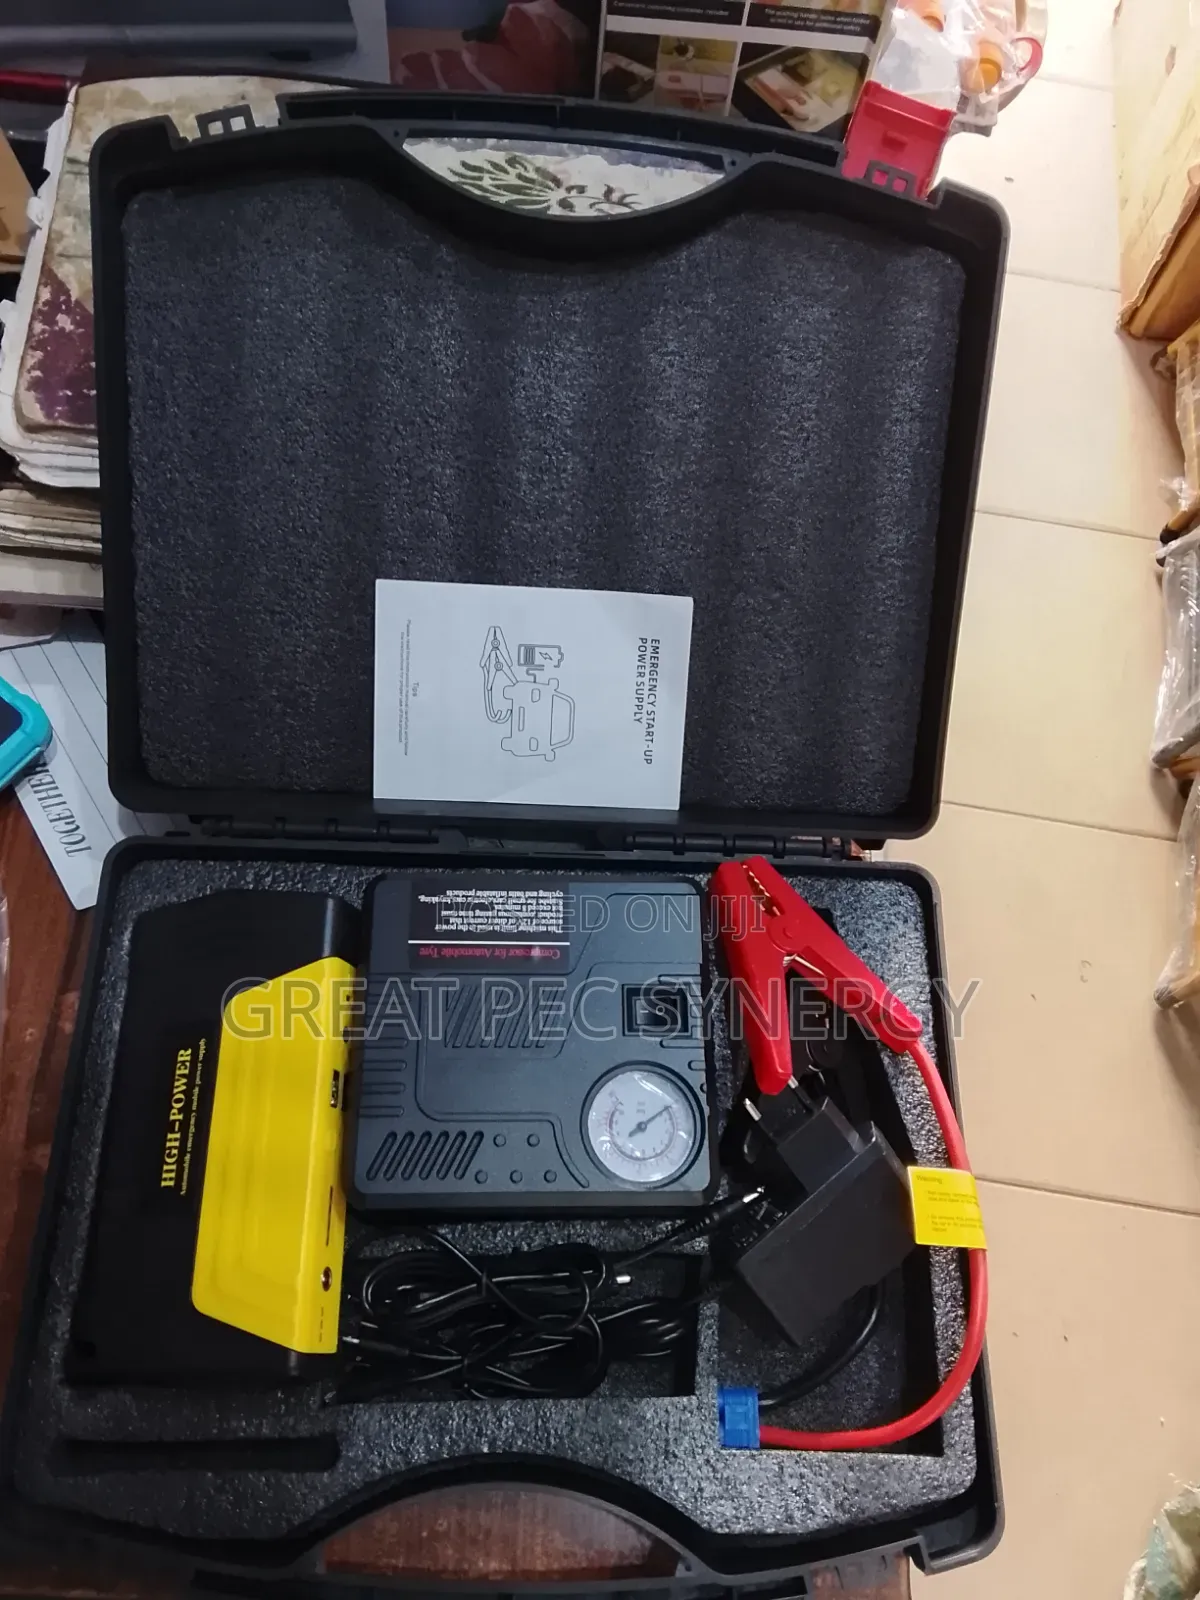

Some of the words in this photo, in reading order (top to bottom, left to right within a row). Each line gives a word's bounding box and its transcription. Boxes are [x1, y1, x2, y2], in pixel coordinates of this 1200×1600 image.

[636, 637, 648, 678] POWER
[646, 638, 660, 707] EMERGENCY
[633, 681, 645, 724] SUPPLY
[643, 709, 656, 765] START-UP
[435, 923, 457, 931] power
[548, 925, 563, 933] This
[419, 945, 438, 958] Tyre
[441, 947, 493, 958] Automobile
[494, 947, 507, 959] for
[161, 1048, 192, 1187] HIGH-POWER
[180, 1152, 191, 1196] Automobile
[186, 1112, 198, 1152] emergency
[195, 1063, 203, 1085] power
[199, 1037, 207, 1061] supply
